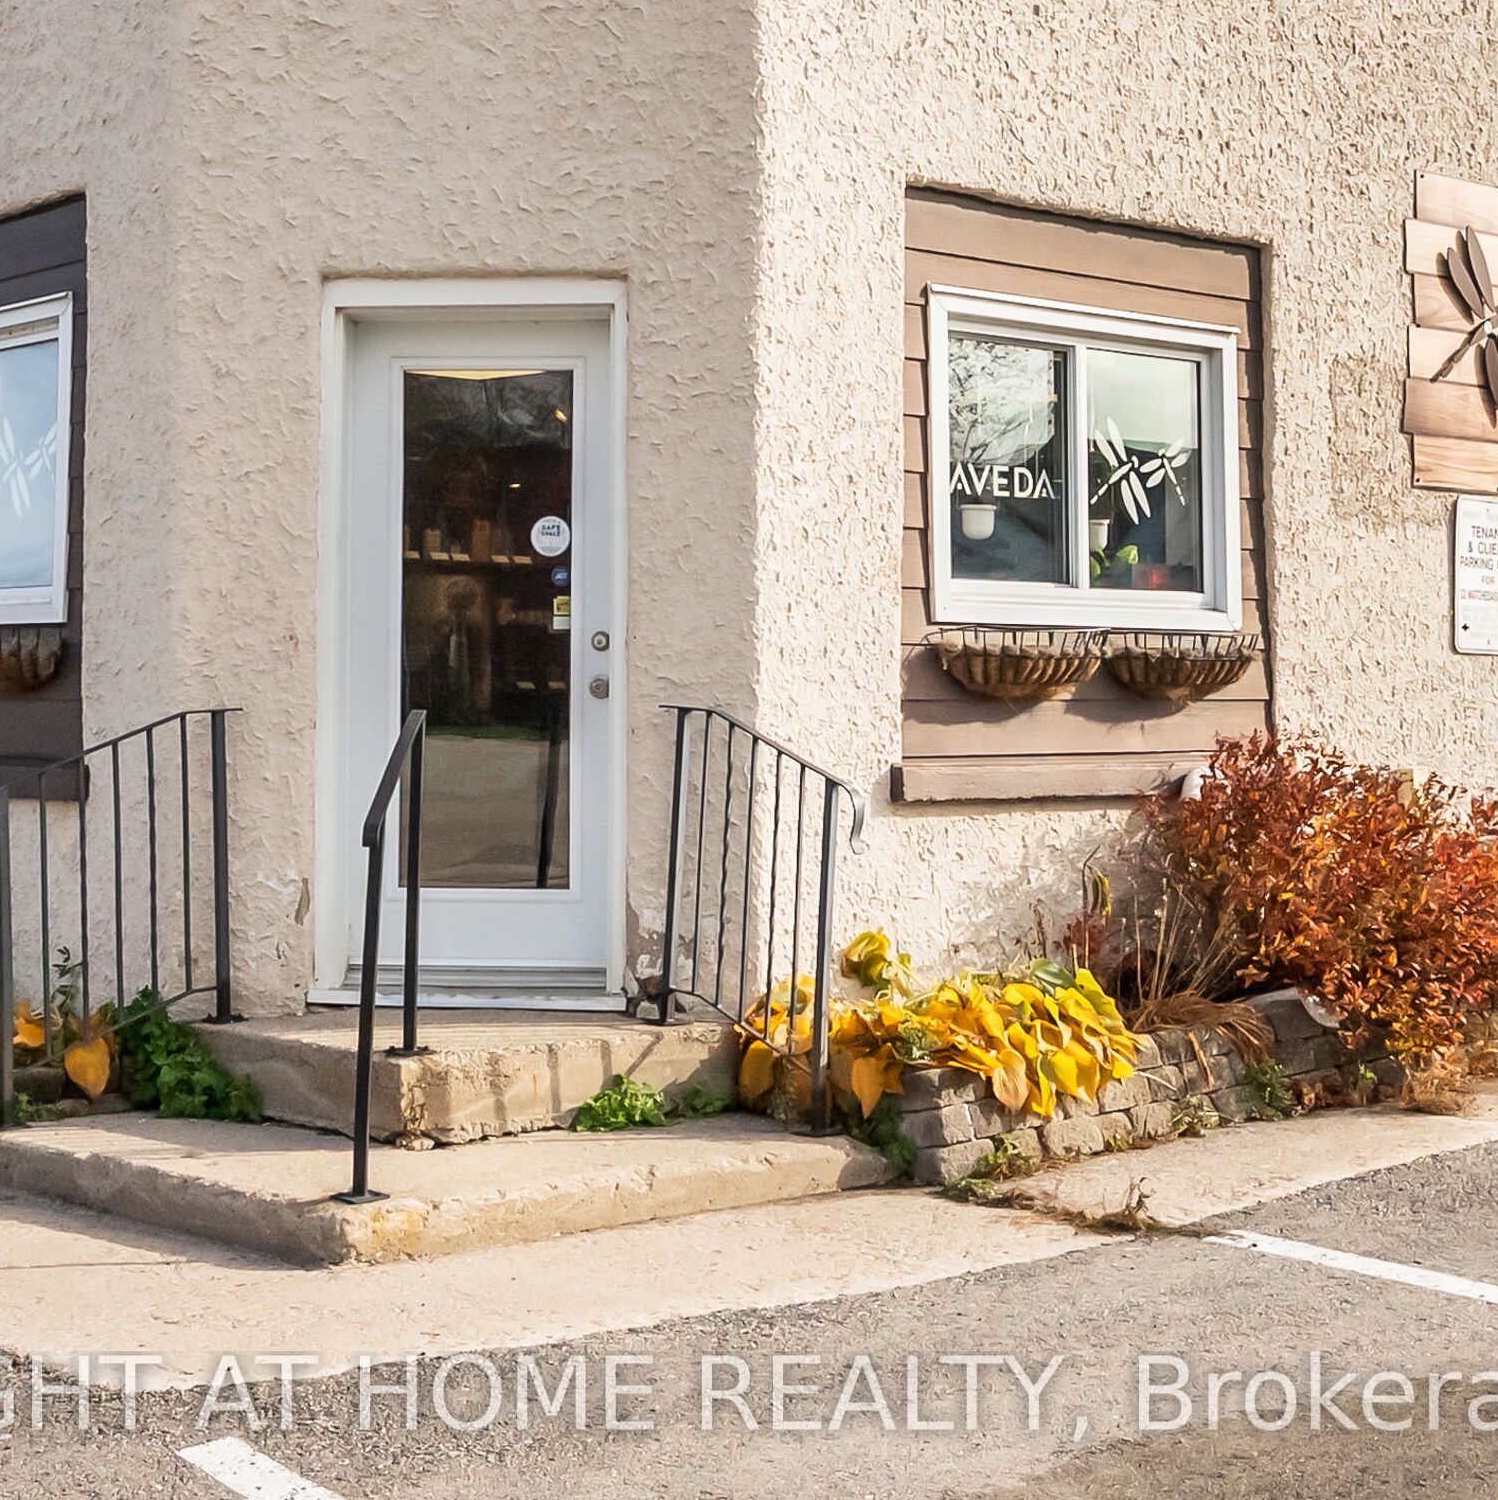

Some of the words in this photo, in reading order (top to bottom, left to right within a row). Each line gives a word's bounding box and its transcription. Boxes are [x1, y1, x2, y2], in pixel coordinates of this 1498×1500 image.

[950, 461, 1055, 499] AVEDA
[1468, 541, 1473, 553] &
[1460, 556, 1493, 571] PARKING
[1481, 576, 1495, 585] FOR
